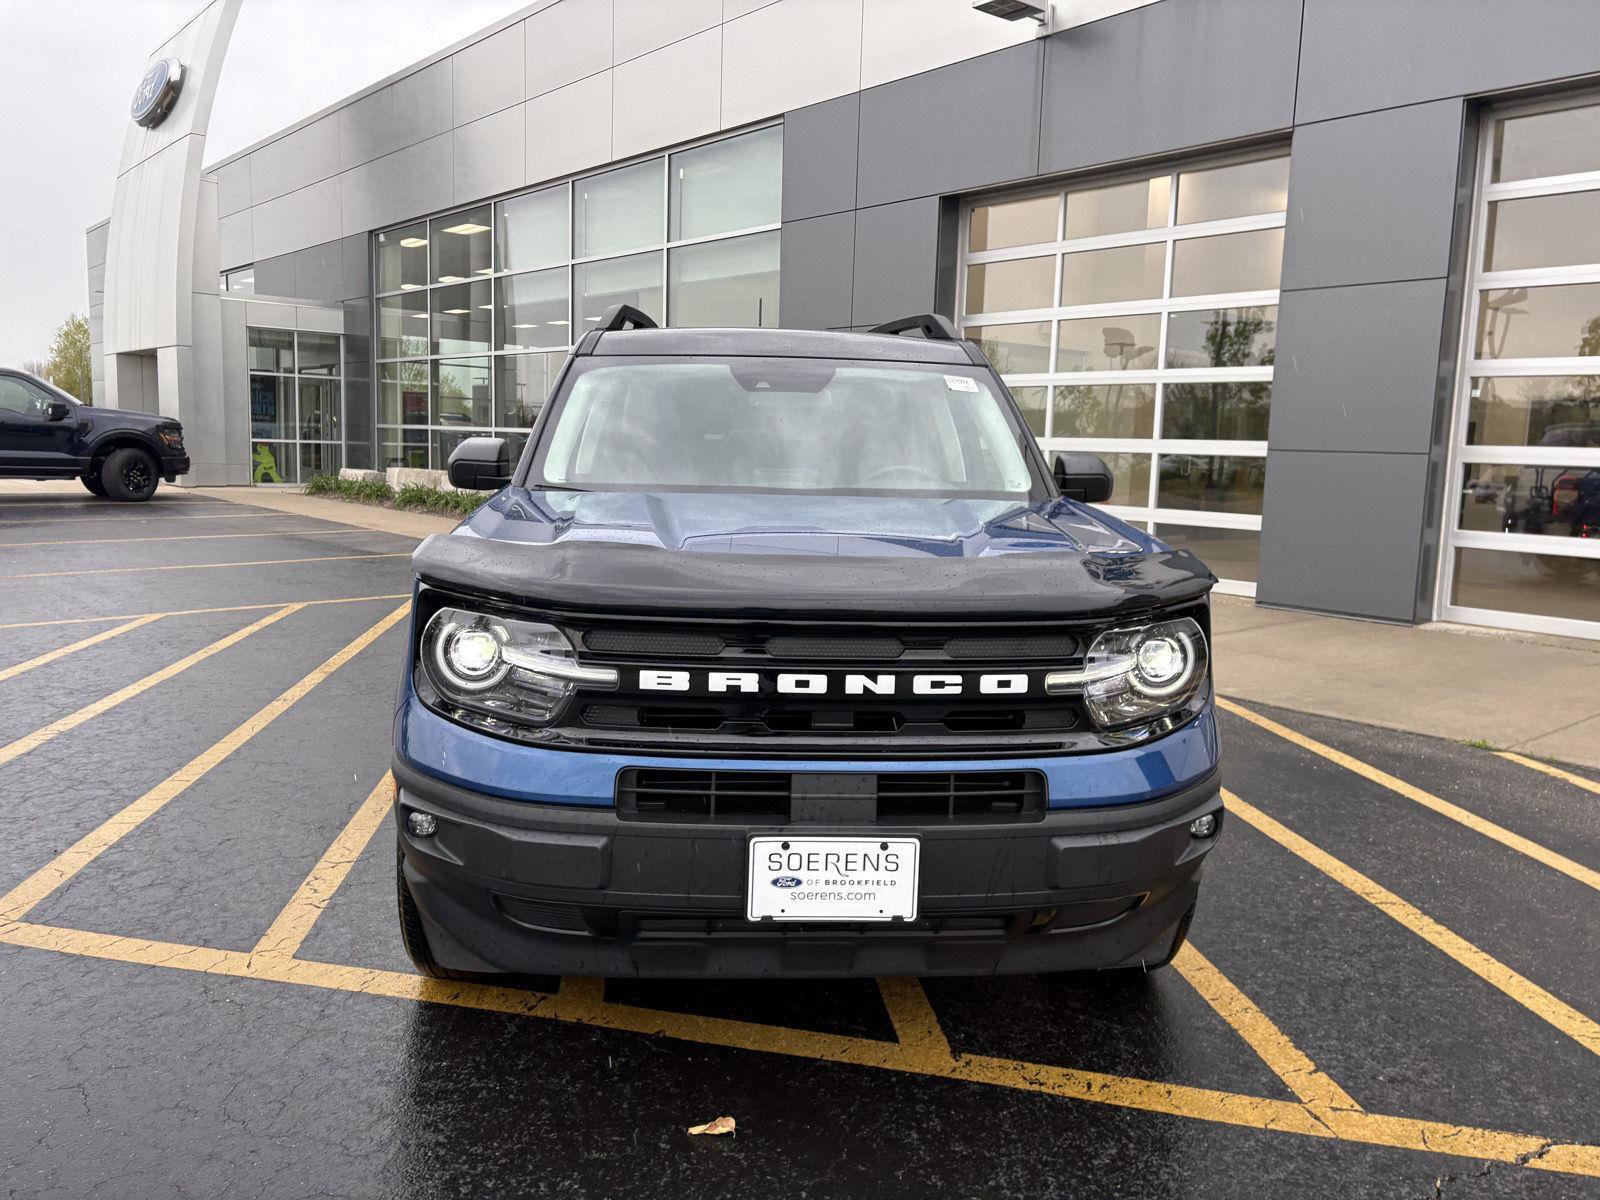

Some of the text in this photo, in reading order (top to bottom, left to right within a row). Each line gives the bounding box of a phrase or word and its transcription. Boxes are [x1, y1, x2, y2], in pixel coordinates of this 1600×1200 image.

[638, 669, 1029, 695] BRONCO
[768, 852, 899, 877] SOERENS
[824, 879, 897, 887] BROOKFIELD
[790, 891, 876, 901] soerens.com
